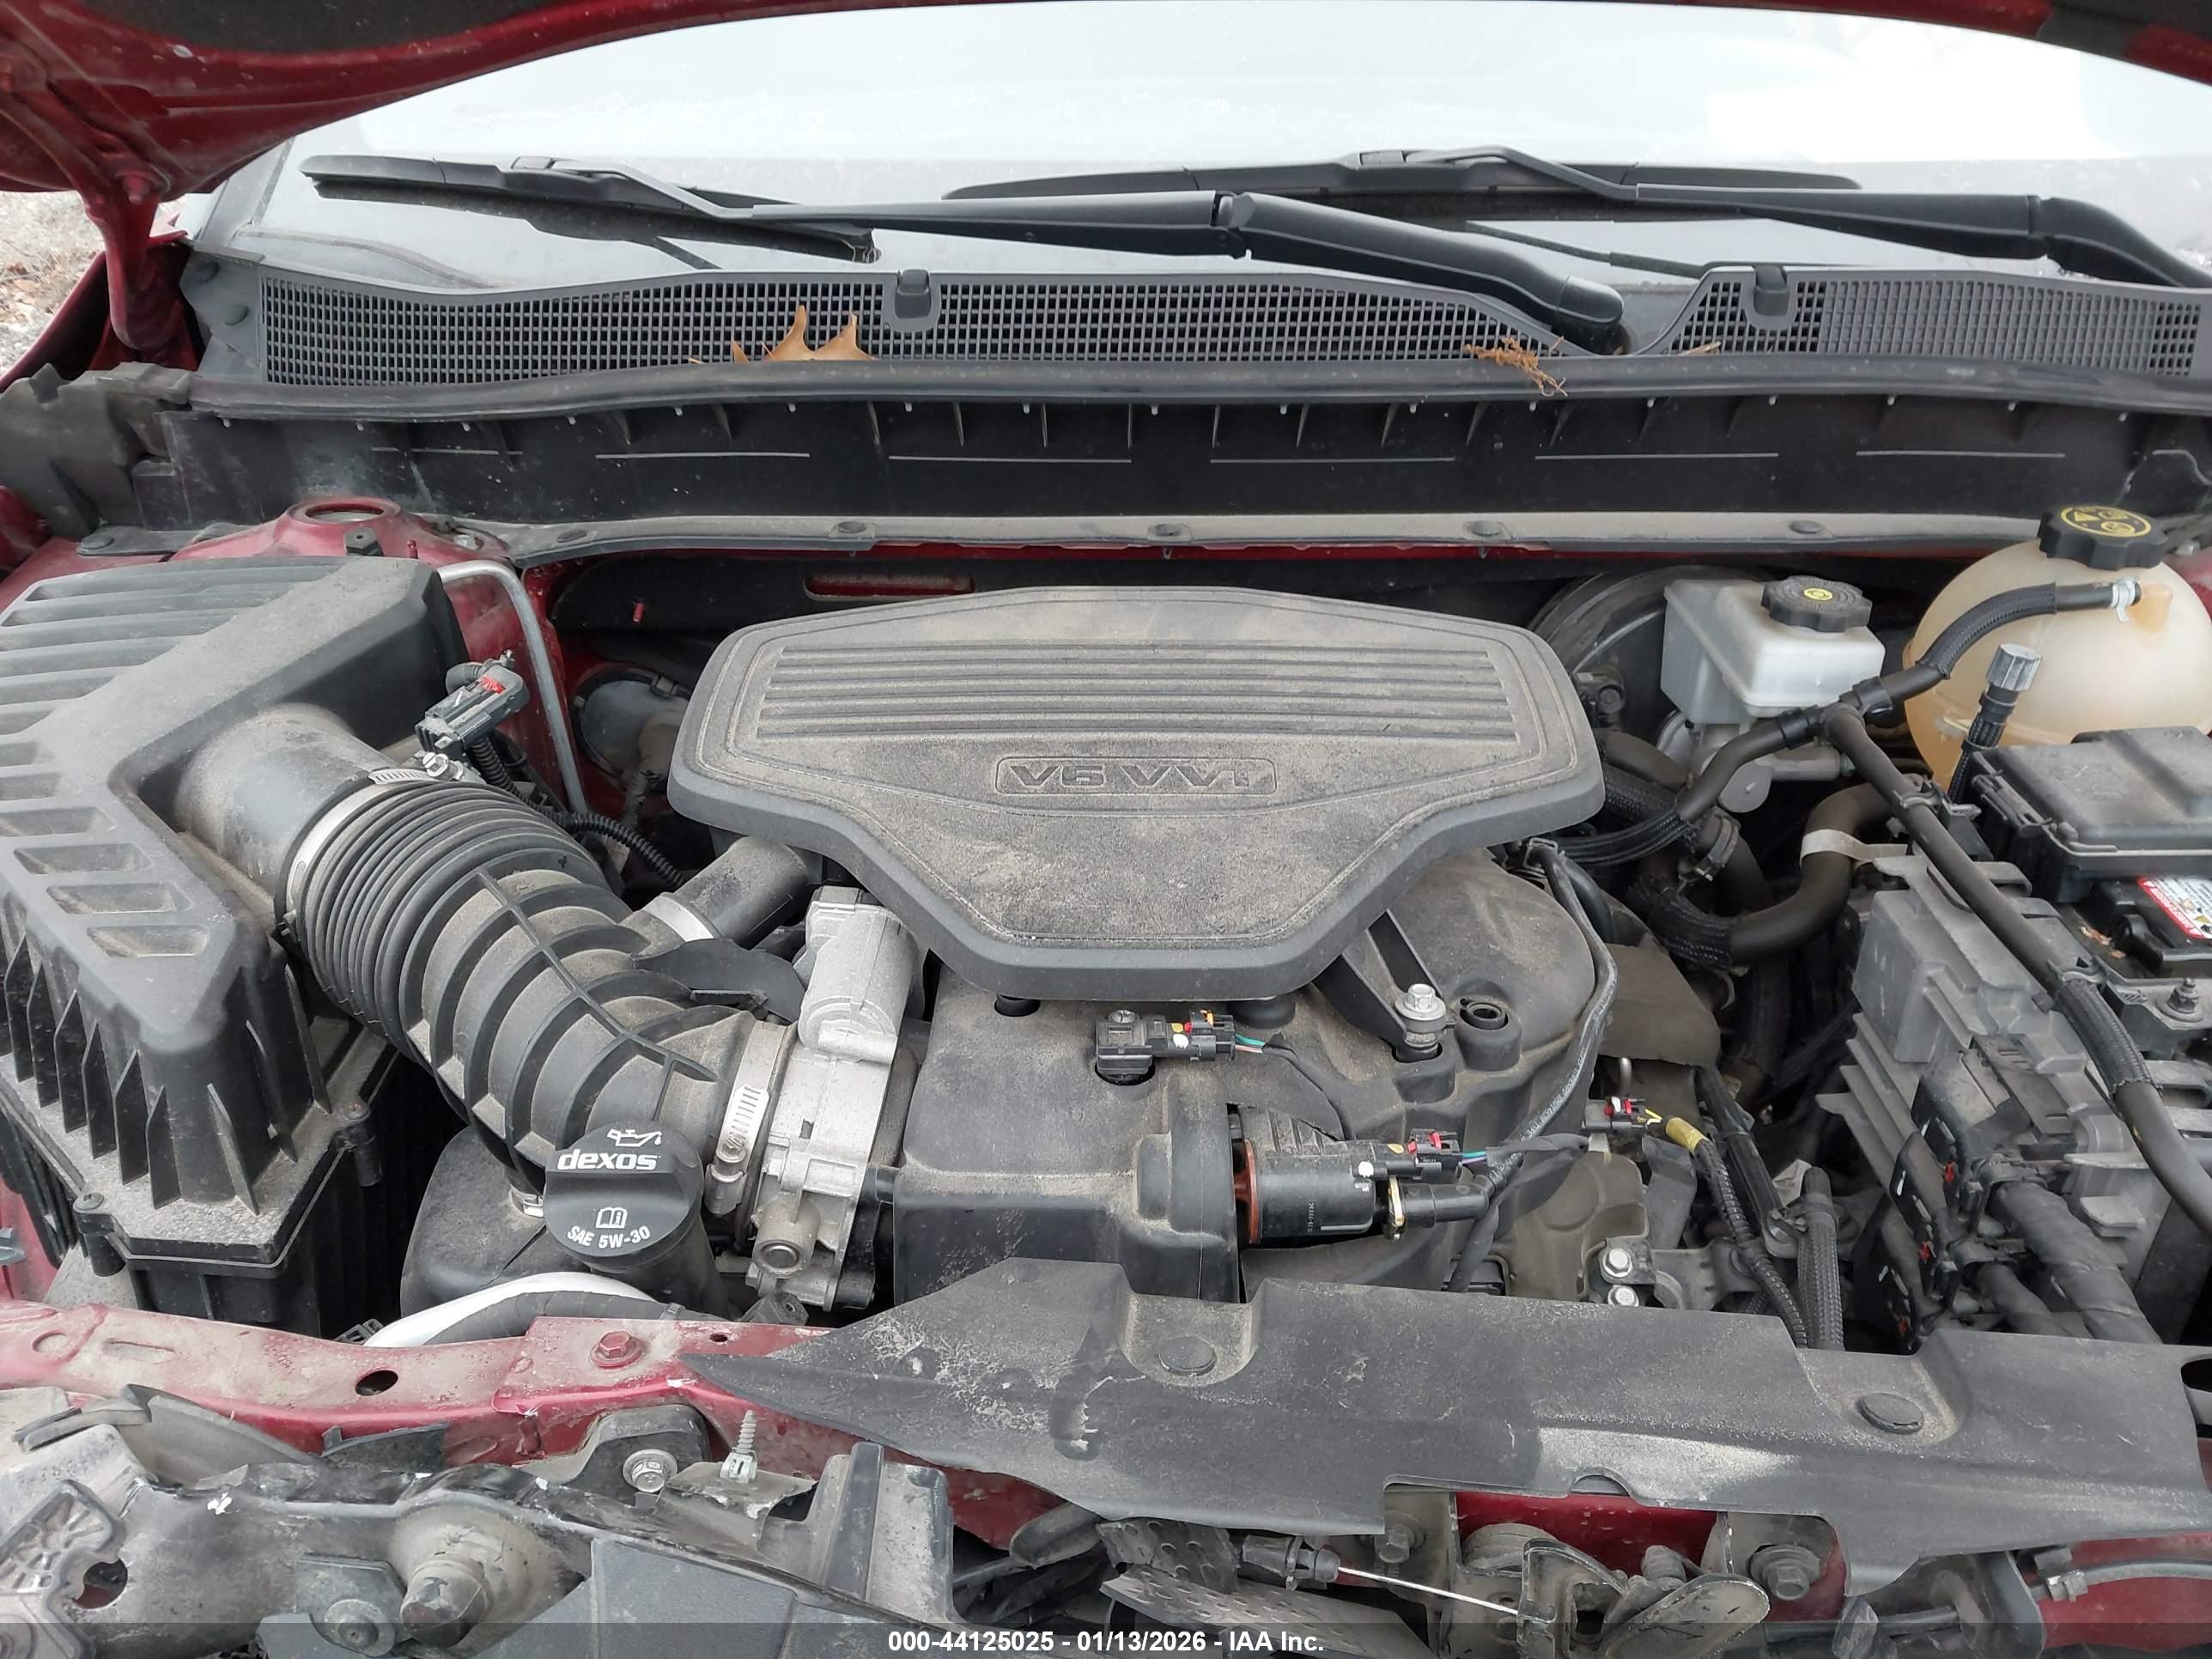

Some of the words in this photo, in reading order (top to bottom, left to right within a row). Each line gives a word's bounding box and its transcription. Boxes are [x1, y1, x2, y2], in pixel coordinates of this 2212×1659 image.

[1010, 764, 1105, 787] V6
[556, 1148, 659, 1170] dexos
[567, 1225, 595, 1247] SAE
[597, 1225, 651, 1249] 5W-30
